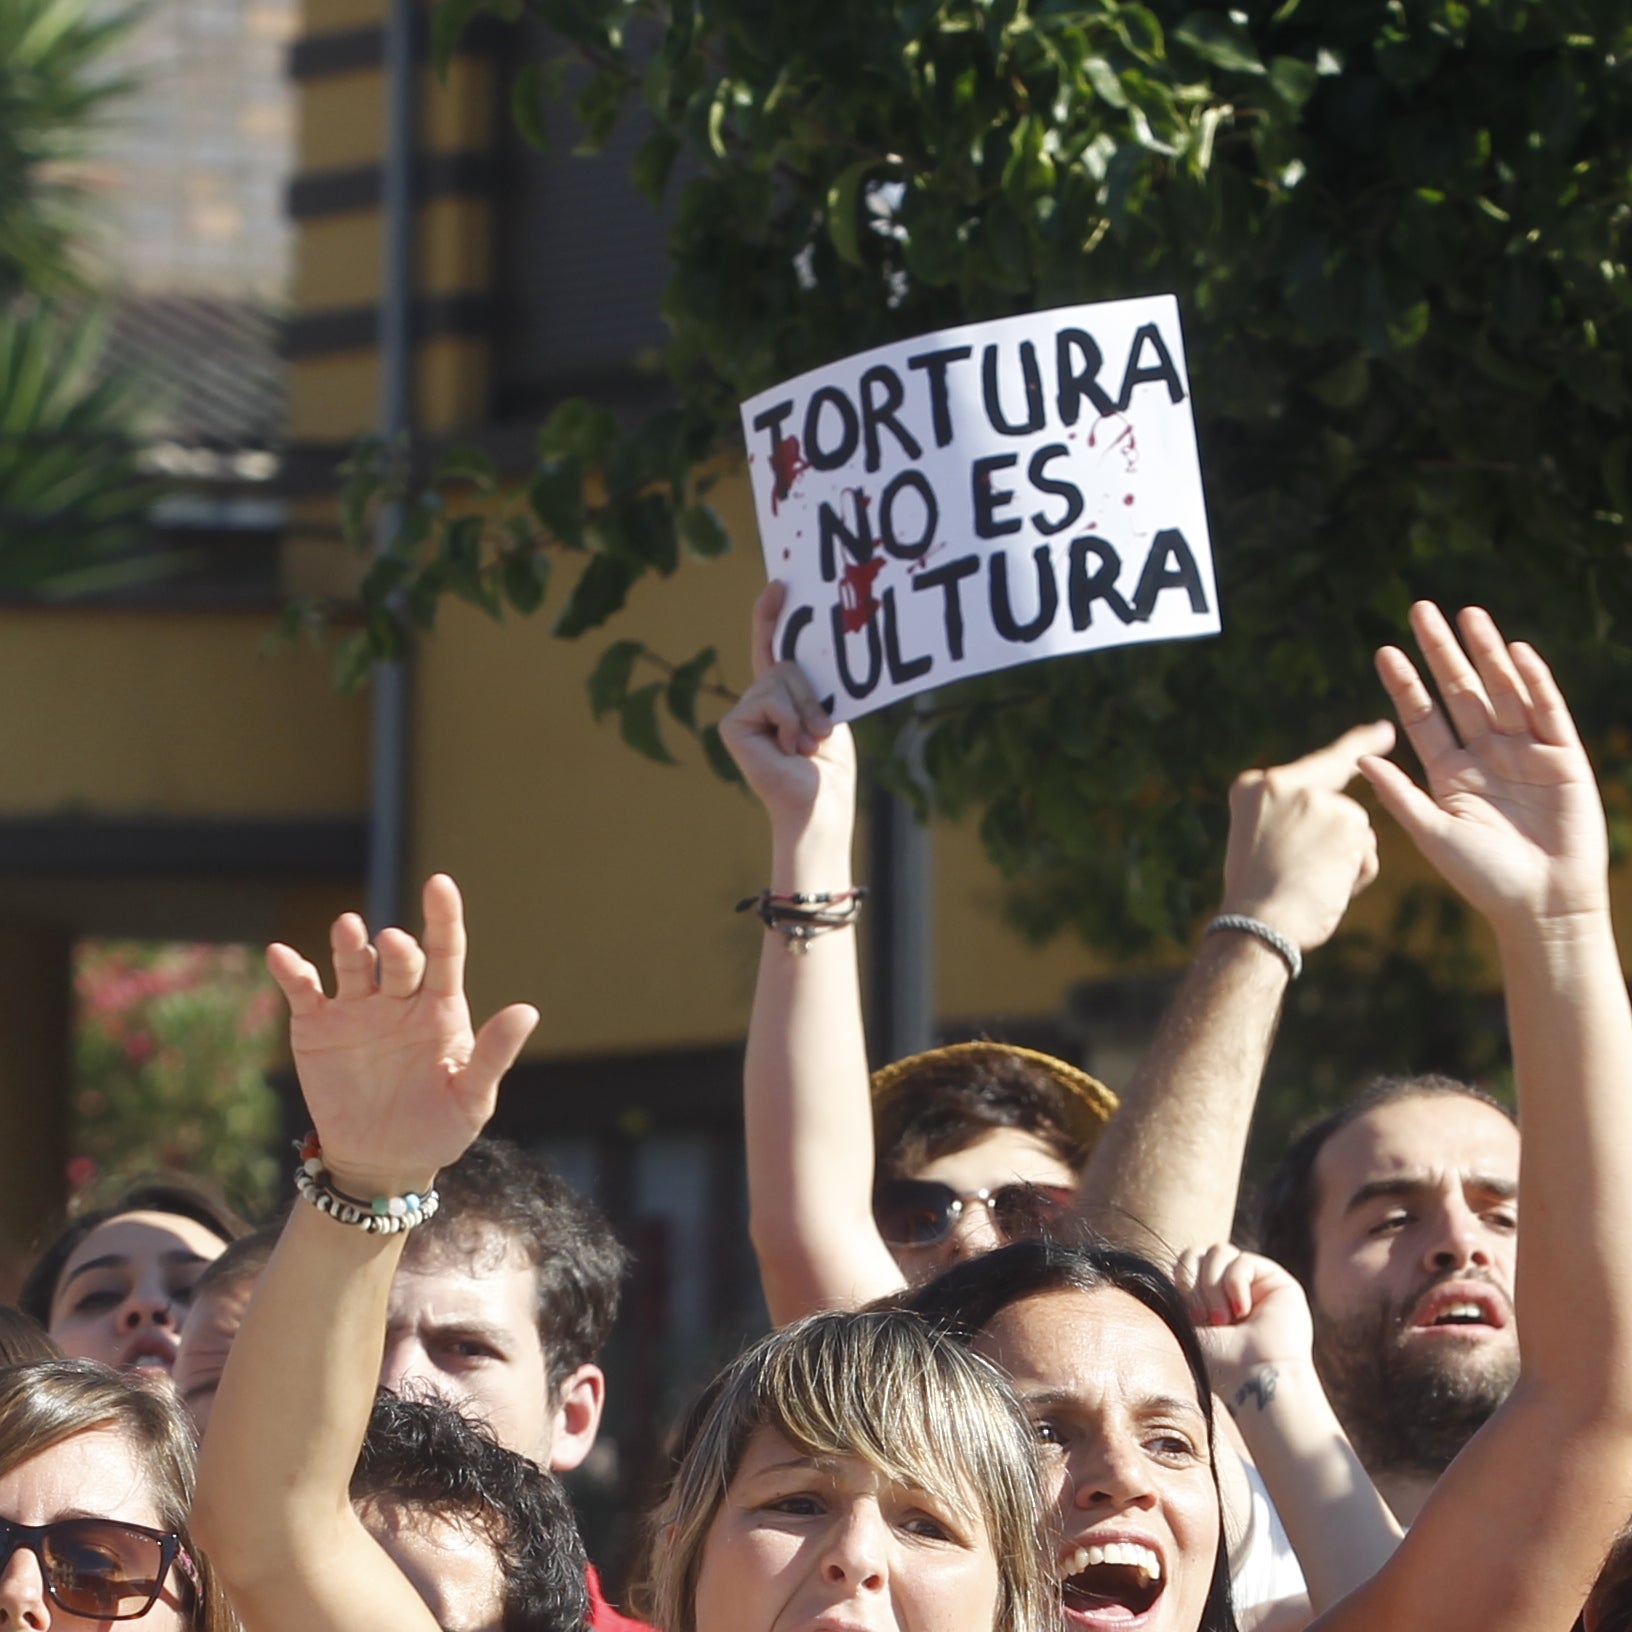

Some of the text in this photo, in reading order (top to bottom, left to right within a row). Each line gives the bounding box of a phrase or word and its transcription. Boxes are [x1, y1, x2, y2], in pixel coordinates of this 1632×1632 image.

[752, 322, 1187, 501] TORTURA
[818, 443, 1085, 583] NO ES
